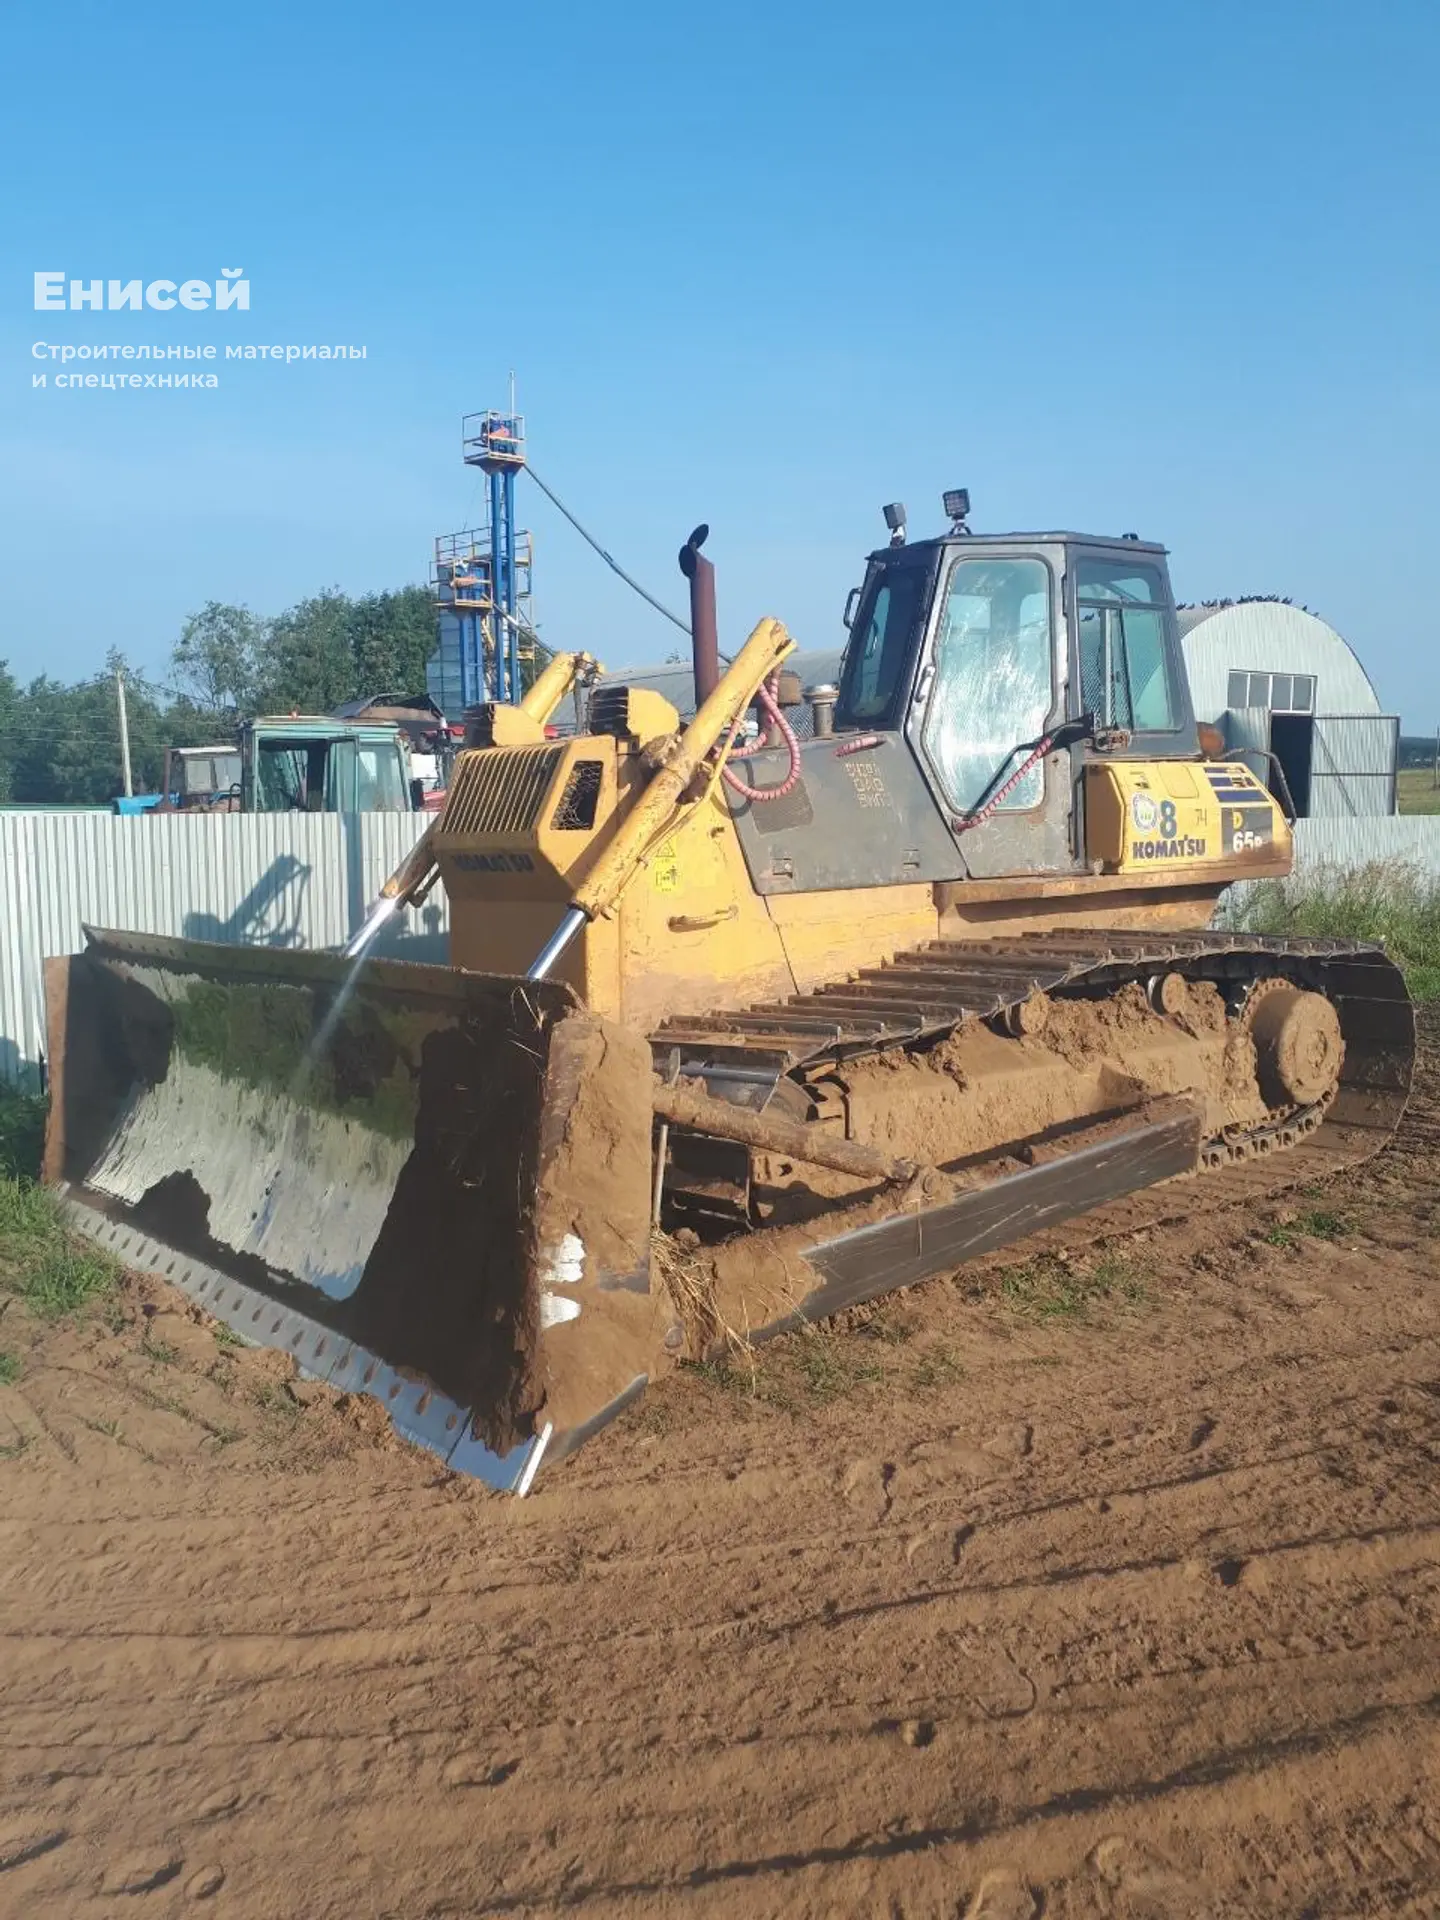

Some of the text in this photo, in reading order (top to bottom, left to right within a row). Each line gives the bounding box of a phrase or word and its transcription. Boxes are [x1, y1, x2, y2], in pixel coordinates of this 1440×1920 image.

[1160, 800, 1177, 839] 8
[1232, 811, 1244, 830] D
[1132, 834, 1206, 859] KOMATSU
